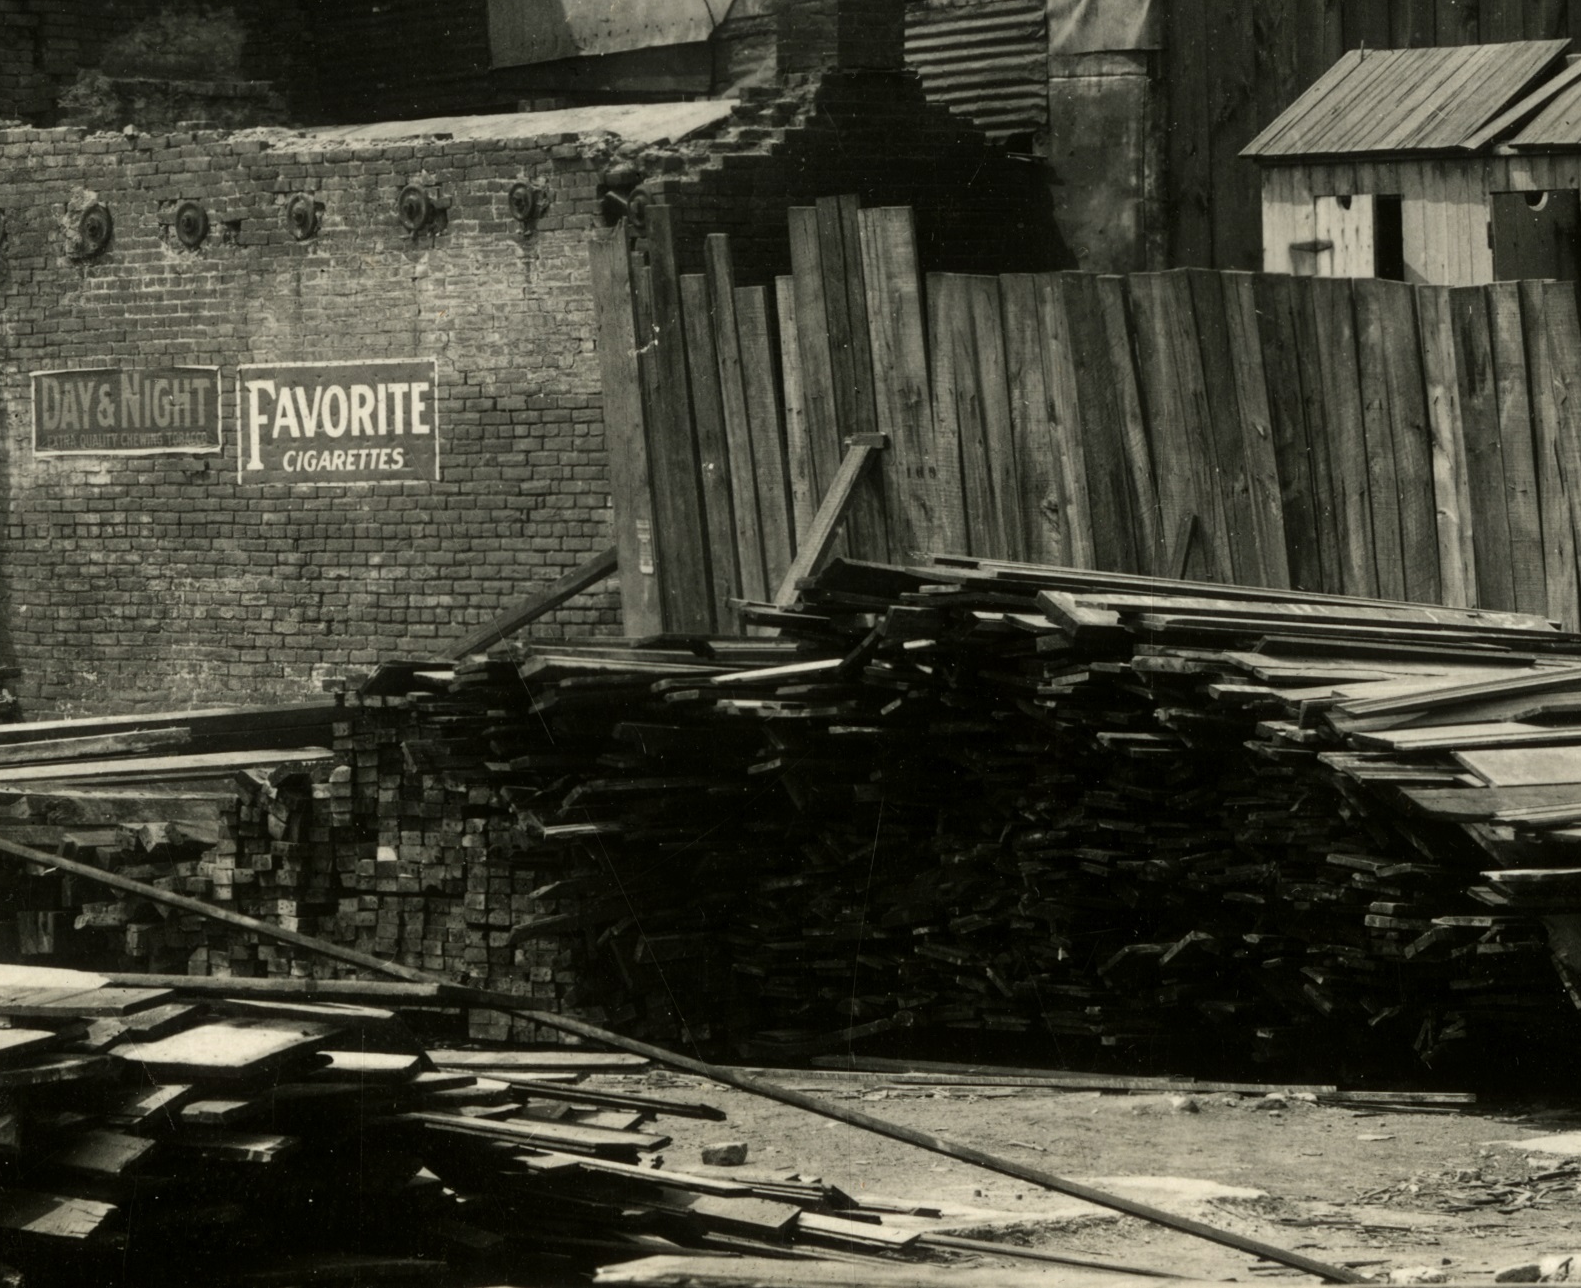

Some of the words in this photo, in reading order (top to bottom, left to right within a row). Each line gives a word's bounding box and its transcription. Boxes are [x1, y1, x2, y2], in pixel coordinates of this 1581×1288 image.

[41, 377, 95, 430] DAY
[120, 371, 211, 429] NIGHT
[46, 434, 77, 450] EXTRA
[79, 433, 119, 449] QUALITY
[120, 431, 164, 447] CHEWING
[165, 430, 208, 447] TOBACCO
[244, 380, 431, 471] FAVORITE
[282, 448, 405, 472] CIGARETTES
